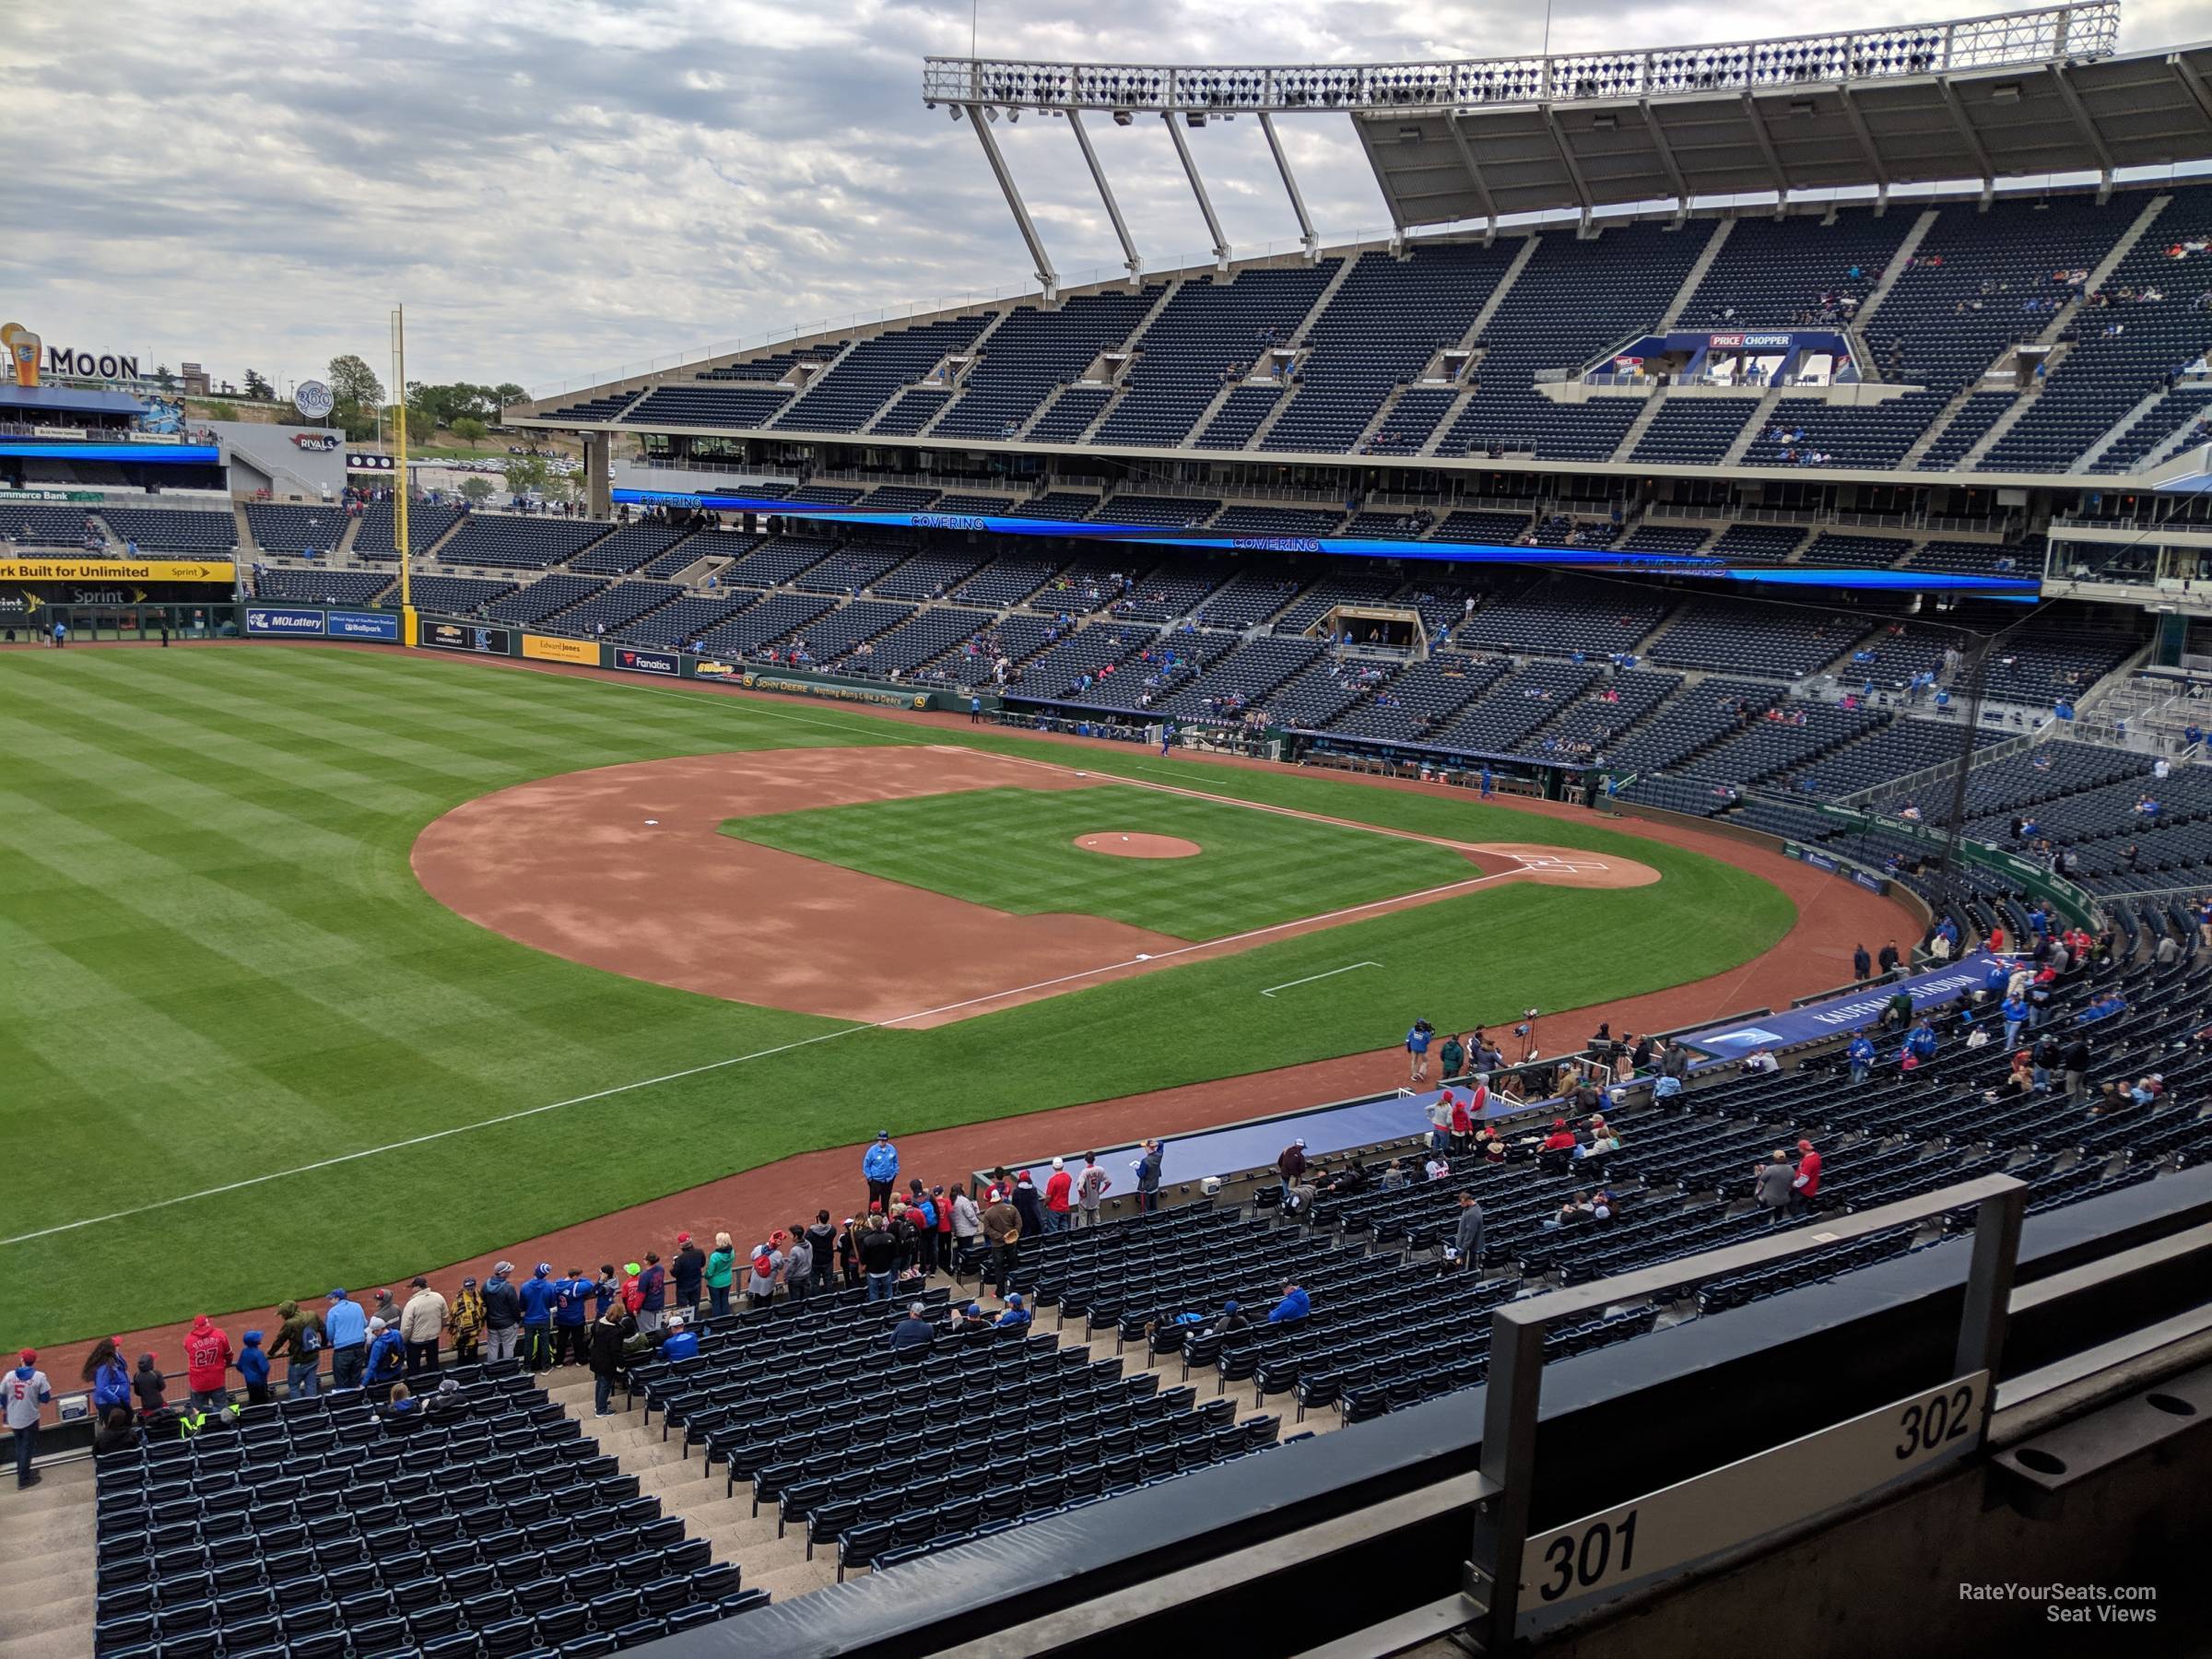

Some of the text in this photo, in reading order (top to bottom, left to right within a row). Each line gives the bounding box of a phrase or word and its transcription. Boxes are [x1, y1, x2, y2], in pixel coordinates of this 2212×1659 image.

[1713, 335, 1789, 345] PRICE CHOPPER
[49, 347, 139, 380] MOON
[298, 387, 332, 411] 360
[300, 439, 334, 449] RIVALS
[43, 491, 68, 500] Bank
[640, 495, 702, 508] COVERING
[912, 516, 984, 531] COVERING
[1232, 537, 1319, 552] COVERING
[19, 567, 53, 577] Built
[55, 567, 76, 577] for
[80, 567, 149, 578] Unlimited
[171, 569, 197, 577] Sprint
[74, 589, 124, 605] Sprint
[272, 617, 322, 629] MOLottery
[353, 625, 382, 633] Ballpark
[636, 657, 671, 671] Fanatics
[757, 678, 809, 693] JOHN DEERE
[1813, 974, 1982, 1025] KAUFFMA STADIUM
[194, 1347, 218, 1368] 27
[14, 1384, 25, 1401] 5
[1895, 1385, 1974, 1461] 302
[1540, 1510, 1639, 1603] 301
